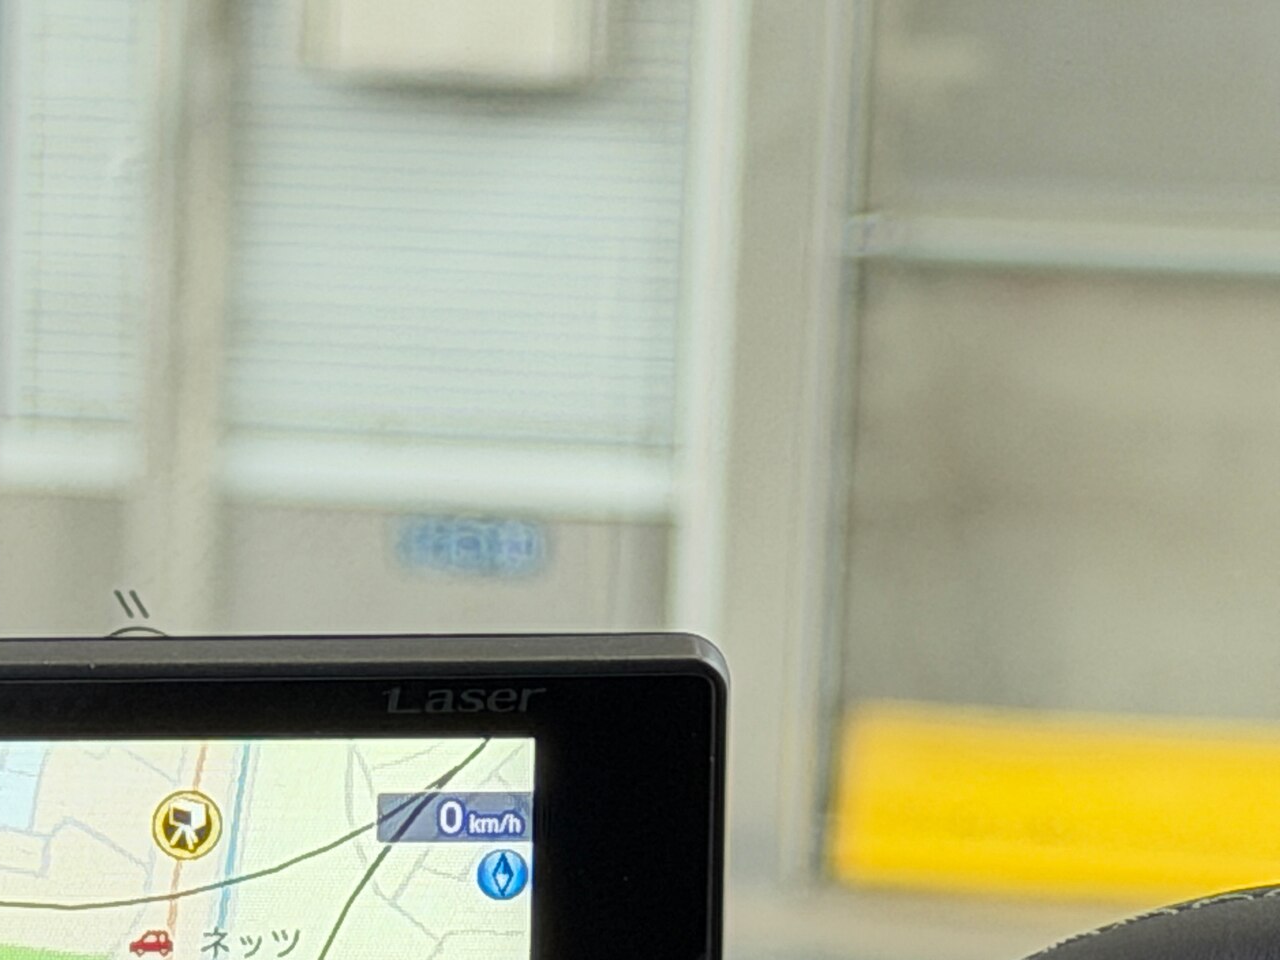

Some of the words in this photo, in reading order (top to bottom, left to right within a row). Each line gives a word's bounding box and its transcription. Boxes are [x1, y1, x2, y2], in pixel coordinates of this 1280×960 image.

[382, 687, 547, 714] Laser
[439, 800, 464, 834] 0
[468, 813, 521, 834] km/h
[201, 926, 301, 959] ネッツ
